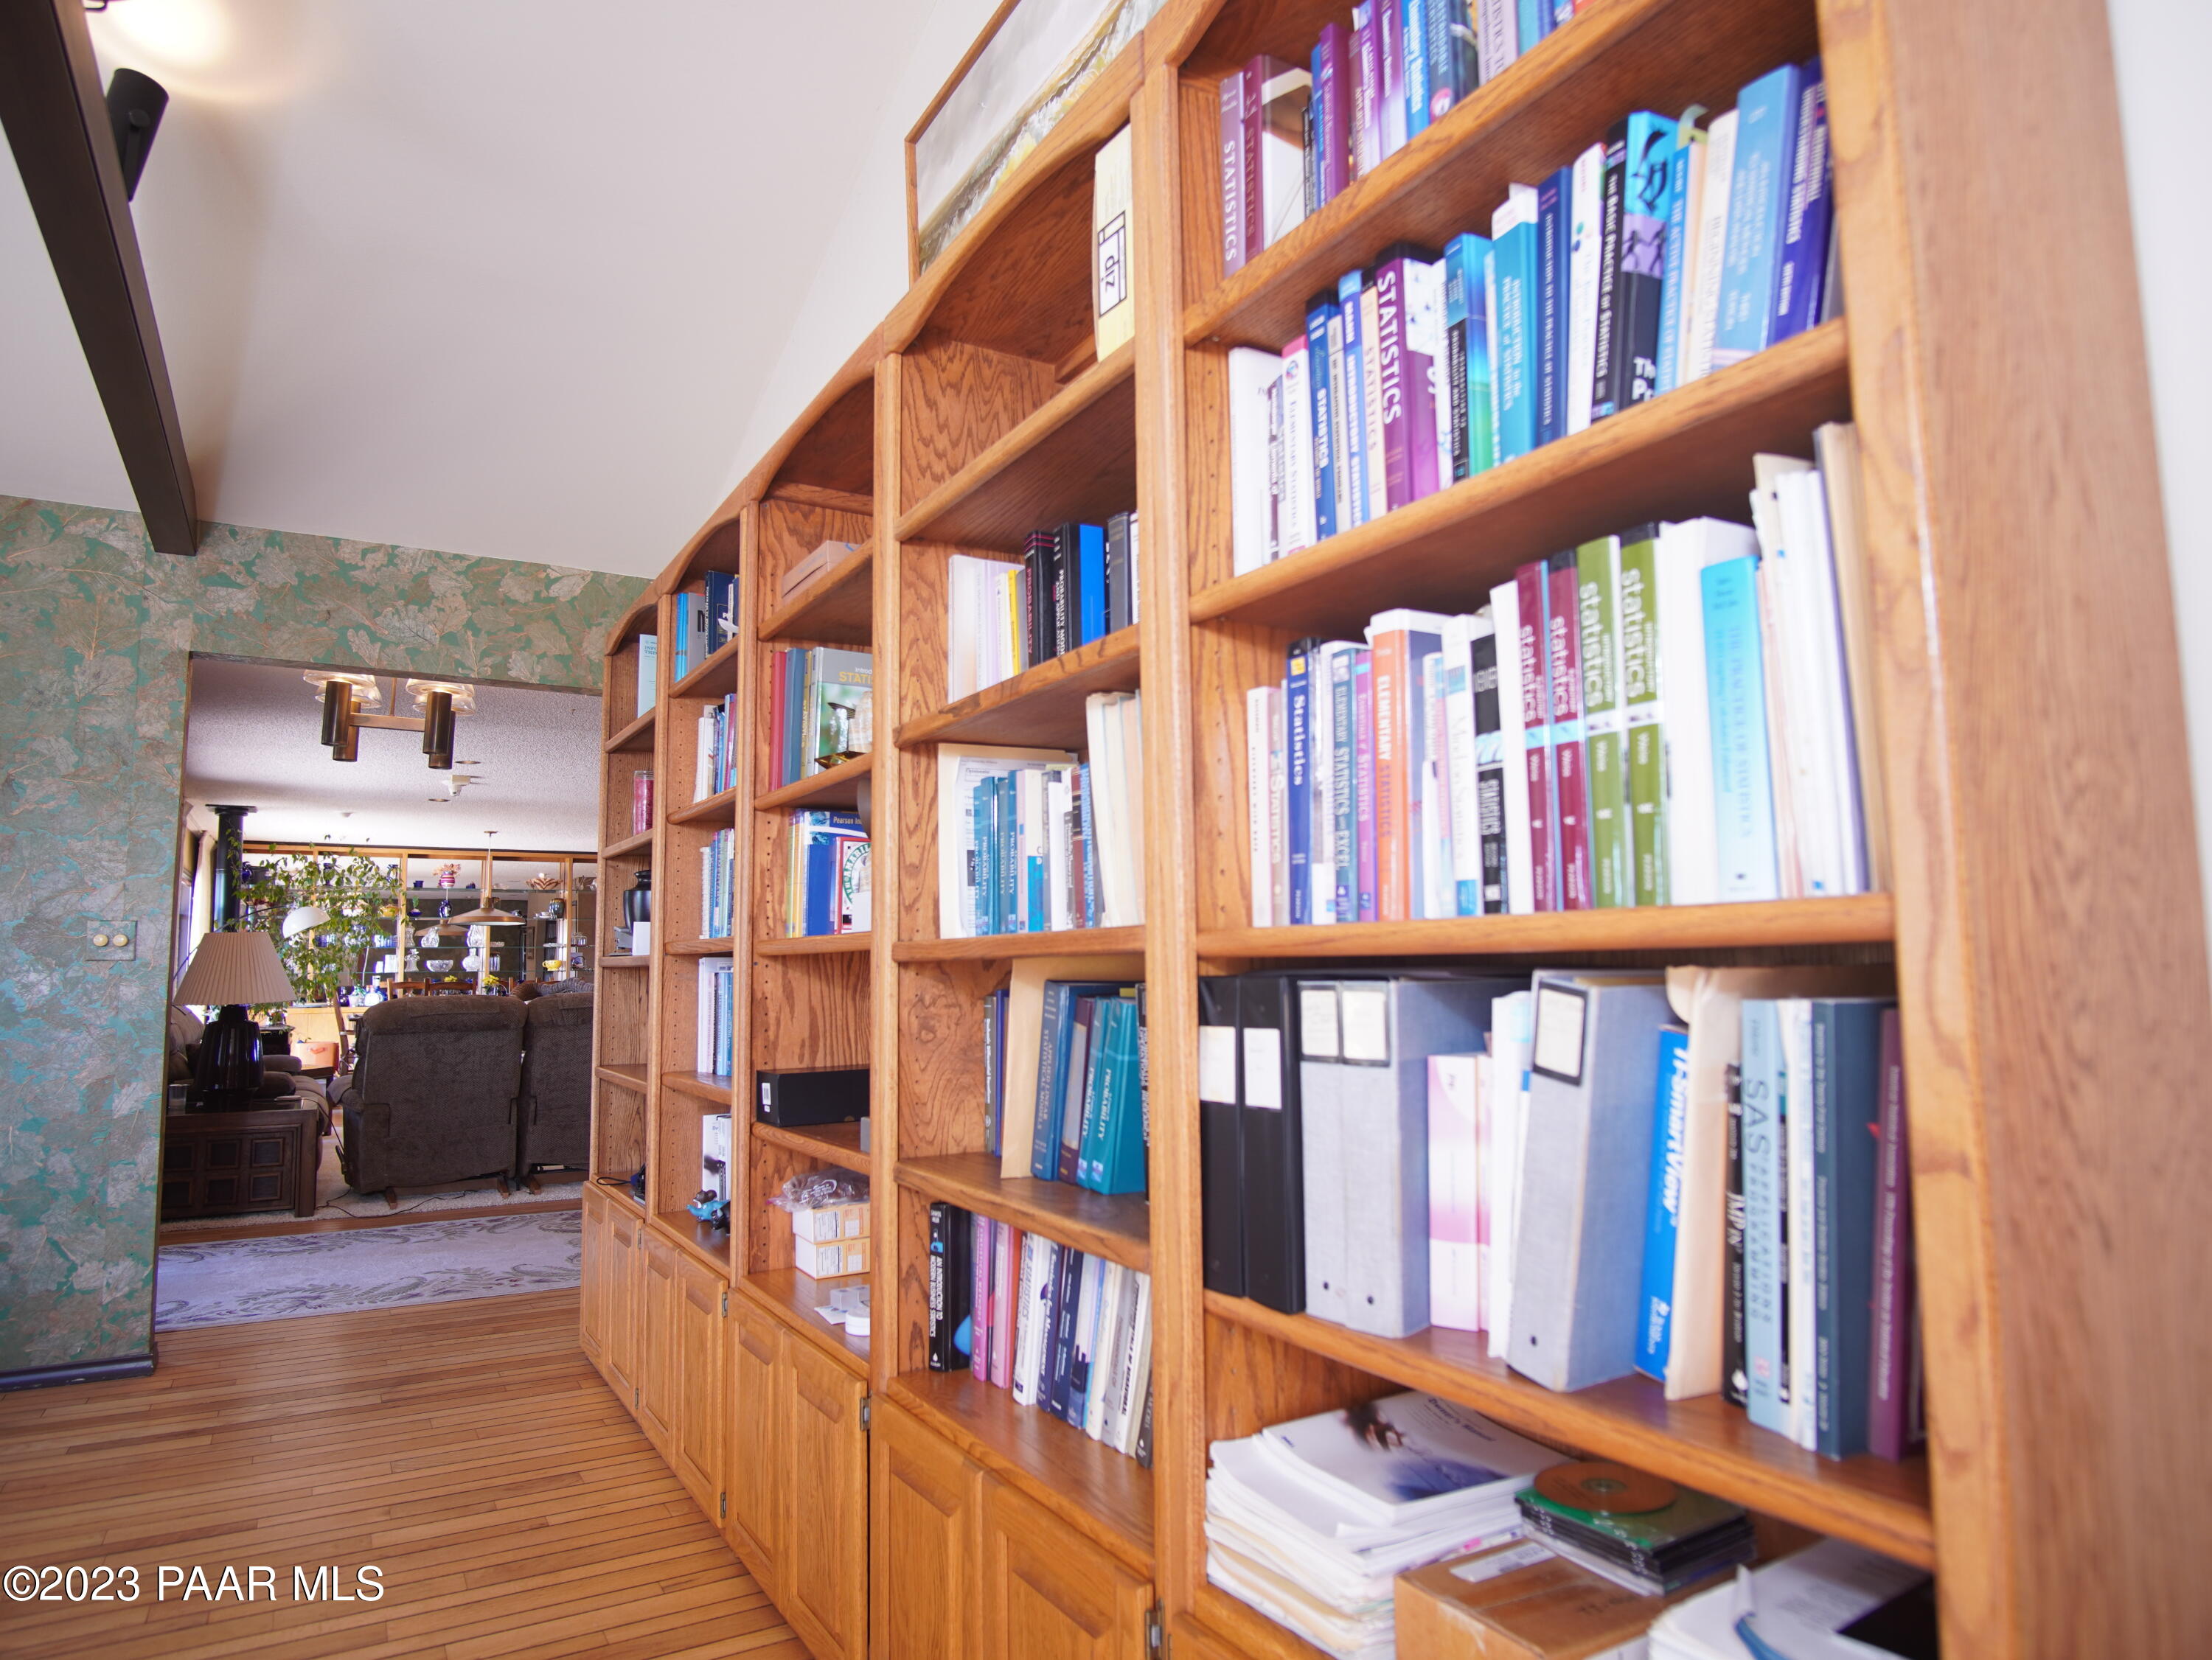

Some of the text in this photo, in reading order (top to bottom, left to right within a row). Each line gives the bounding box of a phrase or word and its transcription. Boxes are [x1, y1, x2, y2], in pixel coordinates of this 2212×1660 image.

[1223, 140, 1238, 262] STATISTICS
[1245, 128, 1255, 237] STATISTICS
[1606, 174, 1616, 198] THE
[1785, 85, 1813, 245] UNDERSTANDING STATISTICS
[1603, 193, 1617, 235] BASIC
[1101, 254, 1119, 293] zip
[1599, 232, 1614, 296] PRACTICE
[1343, 300, 1354, 344] MANN
[1377, 269, 1401, 425] STATISTICS
[1593, 310, 1610, 379] STATISTICS
[1316, 386, 1329, 469] STATISTICS
[1346, 353, 1360, 454] INTRODUCTORY
[1365, 346, 1379, 451] STATISTICS
[1550, 615, 1569, 716] statistics
[1579, 579, 1605, 707] statistics
[1622, 566, 1647, 698] statistics
[1520, 624, 1537, 722] statistics
[1730, 657, 1747, 731] PRACTICE
[1291, 694, 1307, 786] Statistics
[1332, 684, 1350, 869] ELEMENTARY STATISTICS EXCEL
[1376, 674, 1392, 837] ELEMENTARY STATISTICS
[1736, 733, 1748, 756] OF
[832, 815, 854, 824] Pearson
[1270, 774, 1288, 863] STATISTICS
[1356, 752, 1371, 822] STATISTICS
[1479, 778, 1500, 835] STATISTICS
[1736, 758, 1753, 837] STATISTICS
[1040, 1029, 1048, 1087] STATISTICAL
[1081, 1067, 1095, 1138] PROBABILITY
[1097, 1068, 1111, 1140] PROBABILITY
[1748, 1078, 1771, 1157] SAS
[1729, 1193, 1745, 1230] JMP
[1746, 1162, 1761, 1319] PROGRAMMING
[1756, 1164, 1773, 1325] APPLICATIONS
[936, 1255, 942, 1268] AN
[1022, 1263, 1032, 1319] STATISTICS
[936, 1308, 942, 1322] TO
